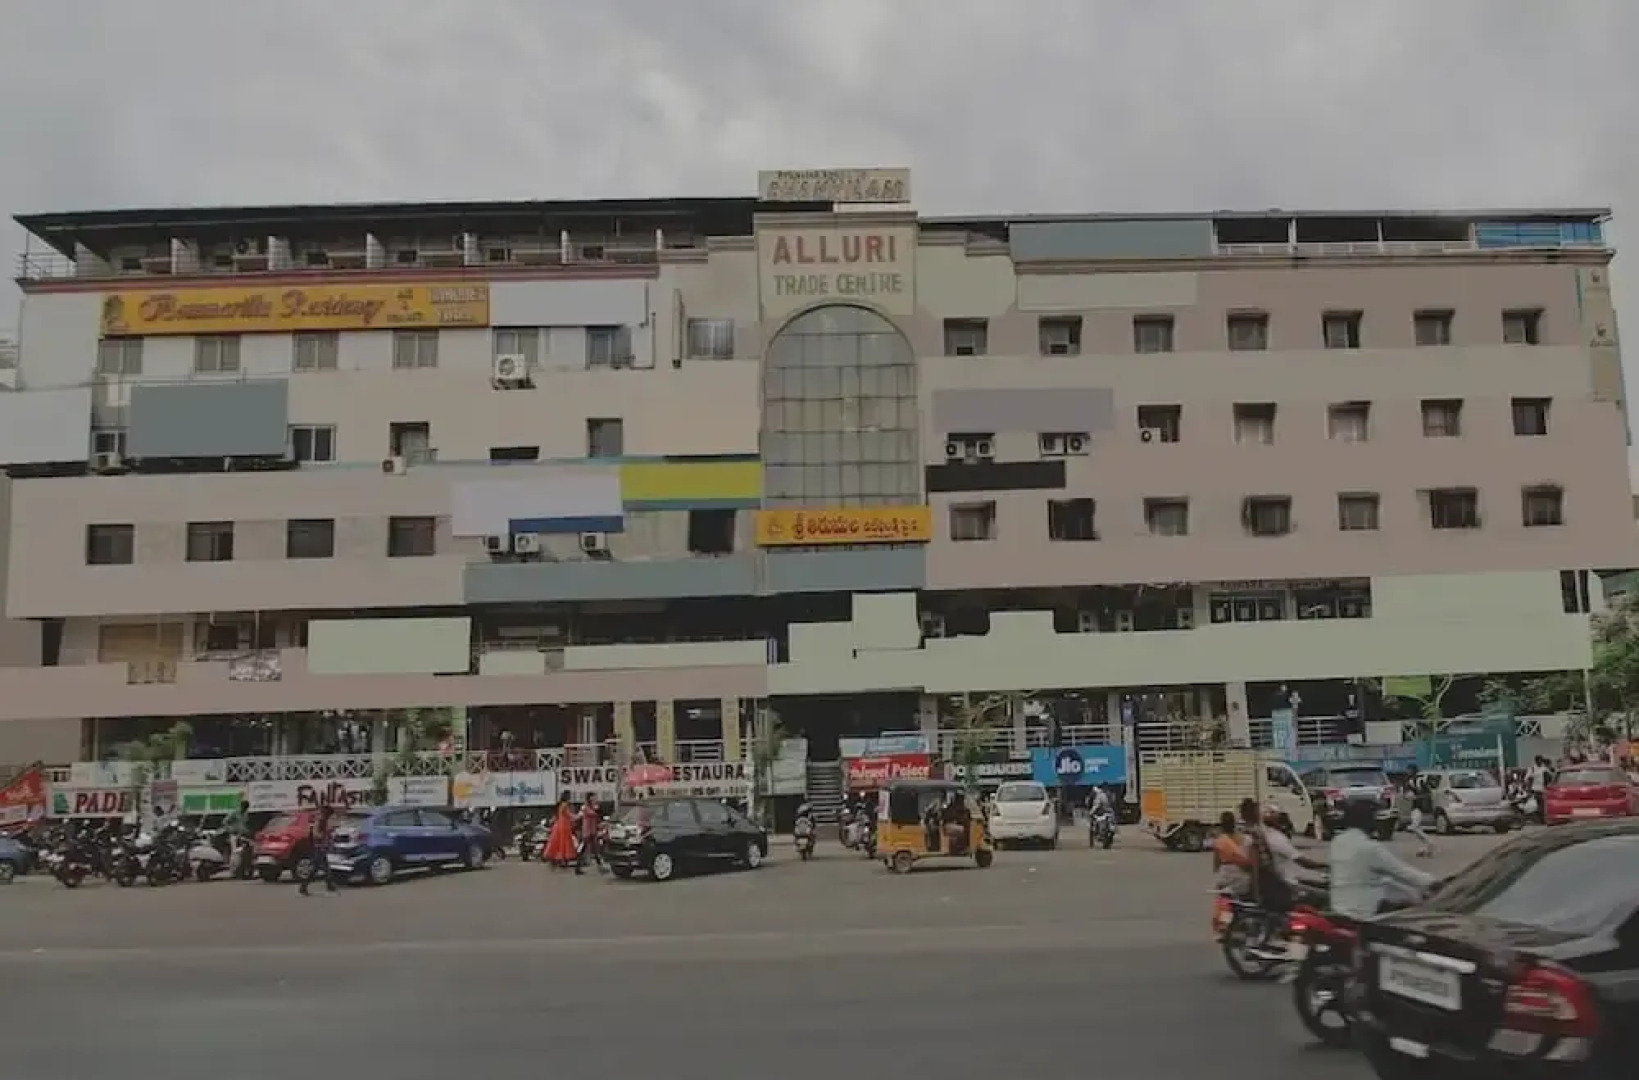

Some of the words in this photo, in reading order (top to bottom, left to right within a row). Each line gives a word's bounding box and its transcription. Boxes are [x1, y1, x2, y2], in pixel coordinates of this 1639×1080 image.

[773, 235, 896, 265] ALLURI
[773, 274, 828, 296] TRADE
[836, 271, 904, 296] CENTRE
[664, 763, 746, 781] ESTAURA
[1057, 757, 1081, 774] Jio
